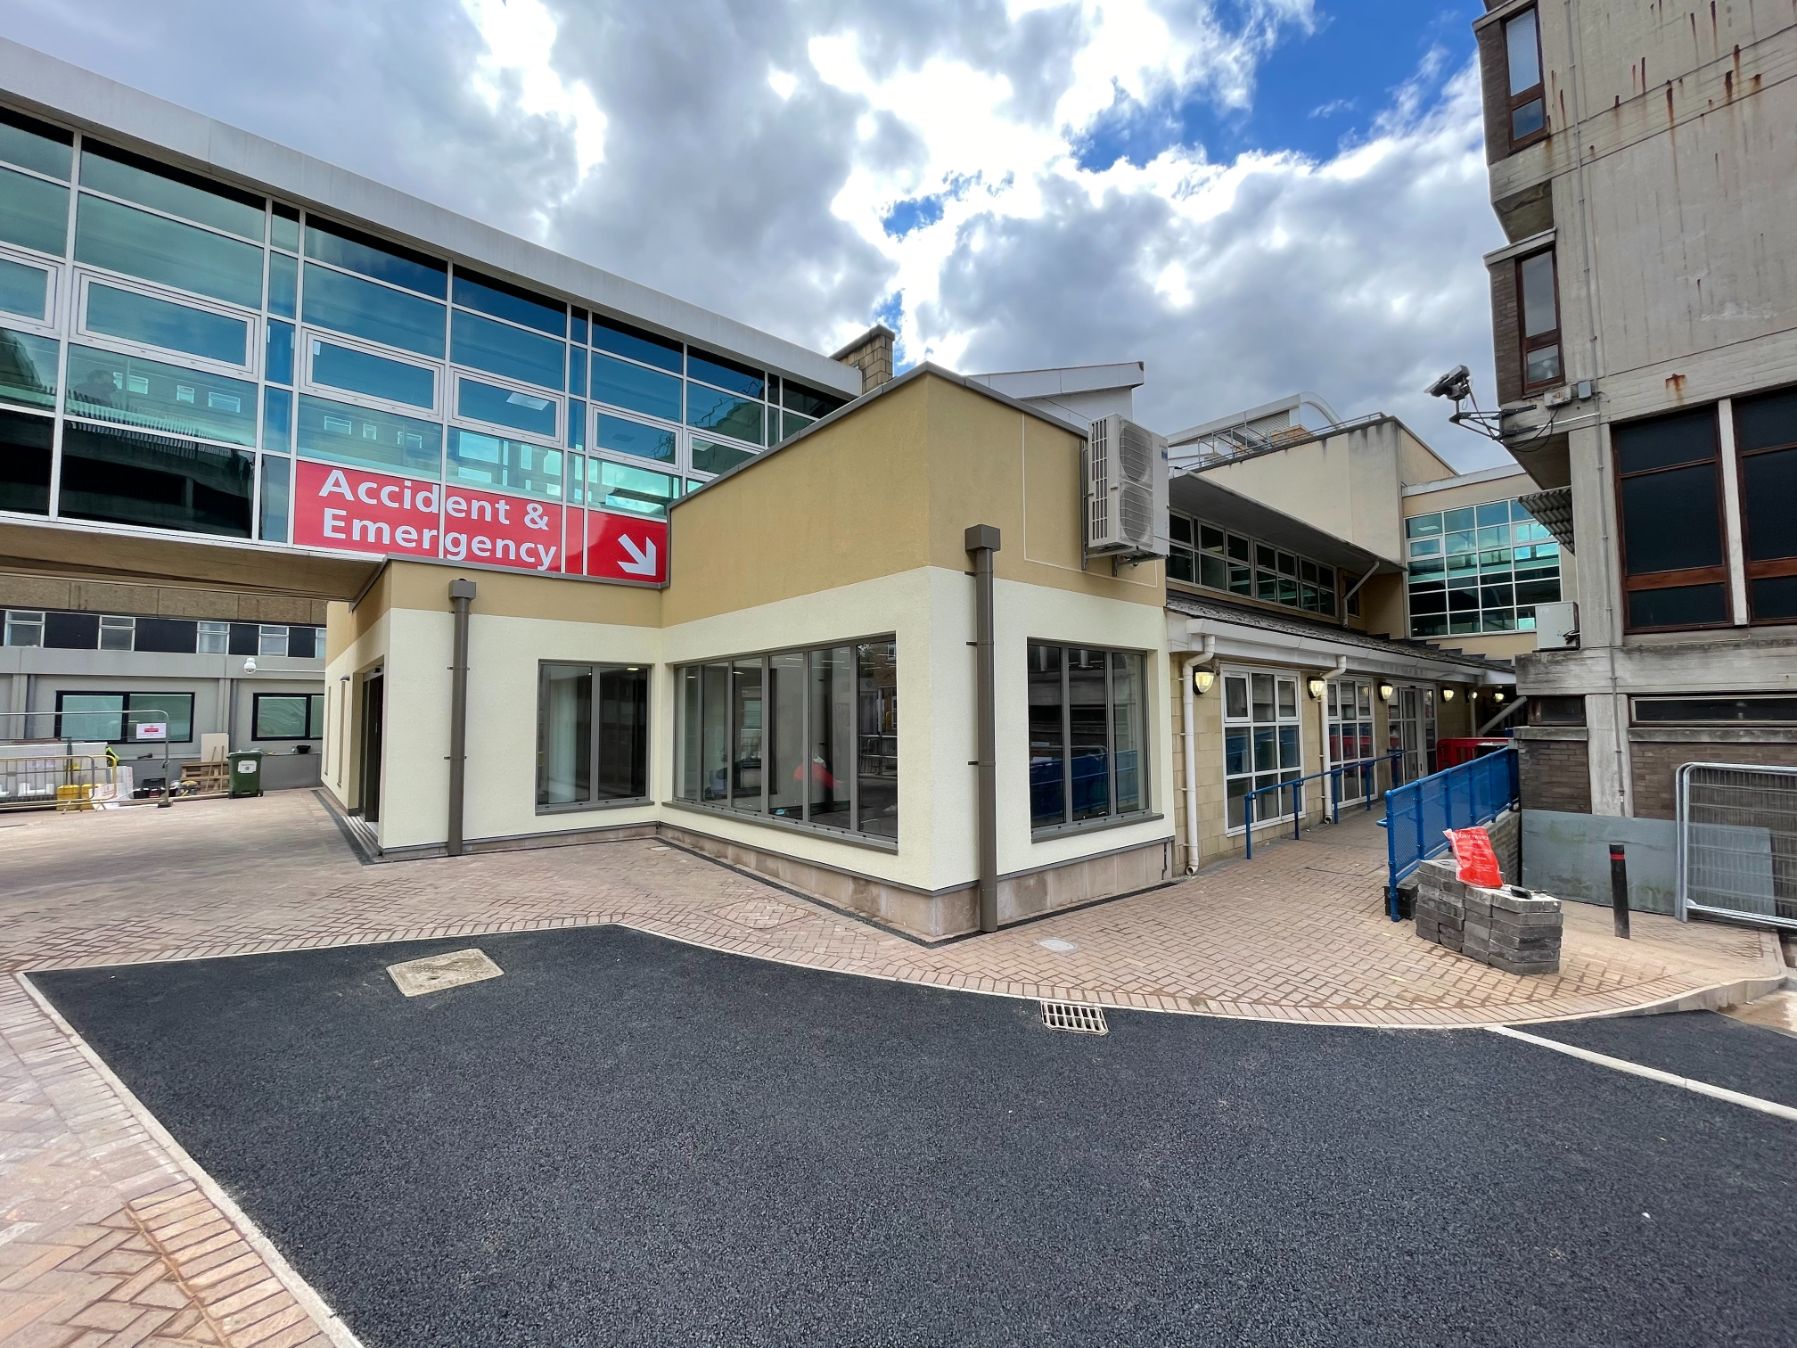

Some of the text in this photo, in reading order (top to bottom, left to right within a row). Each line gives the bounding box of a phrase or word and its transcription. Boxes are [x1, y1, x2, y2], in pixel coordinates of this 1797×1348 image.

[319, 470, 549, 531] Accident &
[323, 508, 557, 571] Emergency
